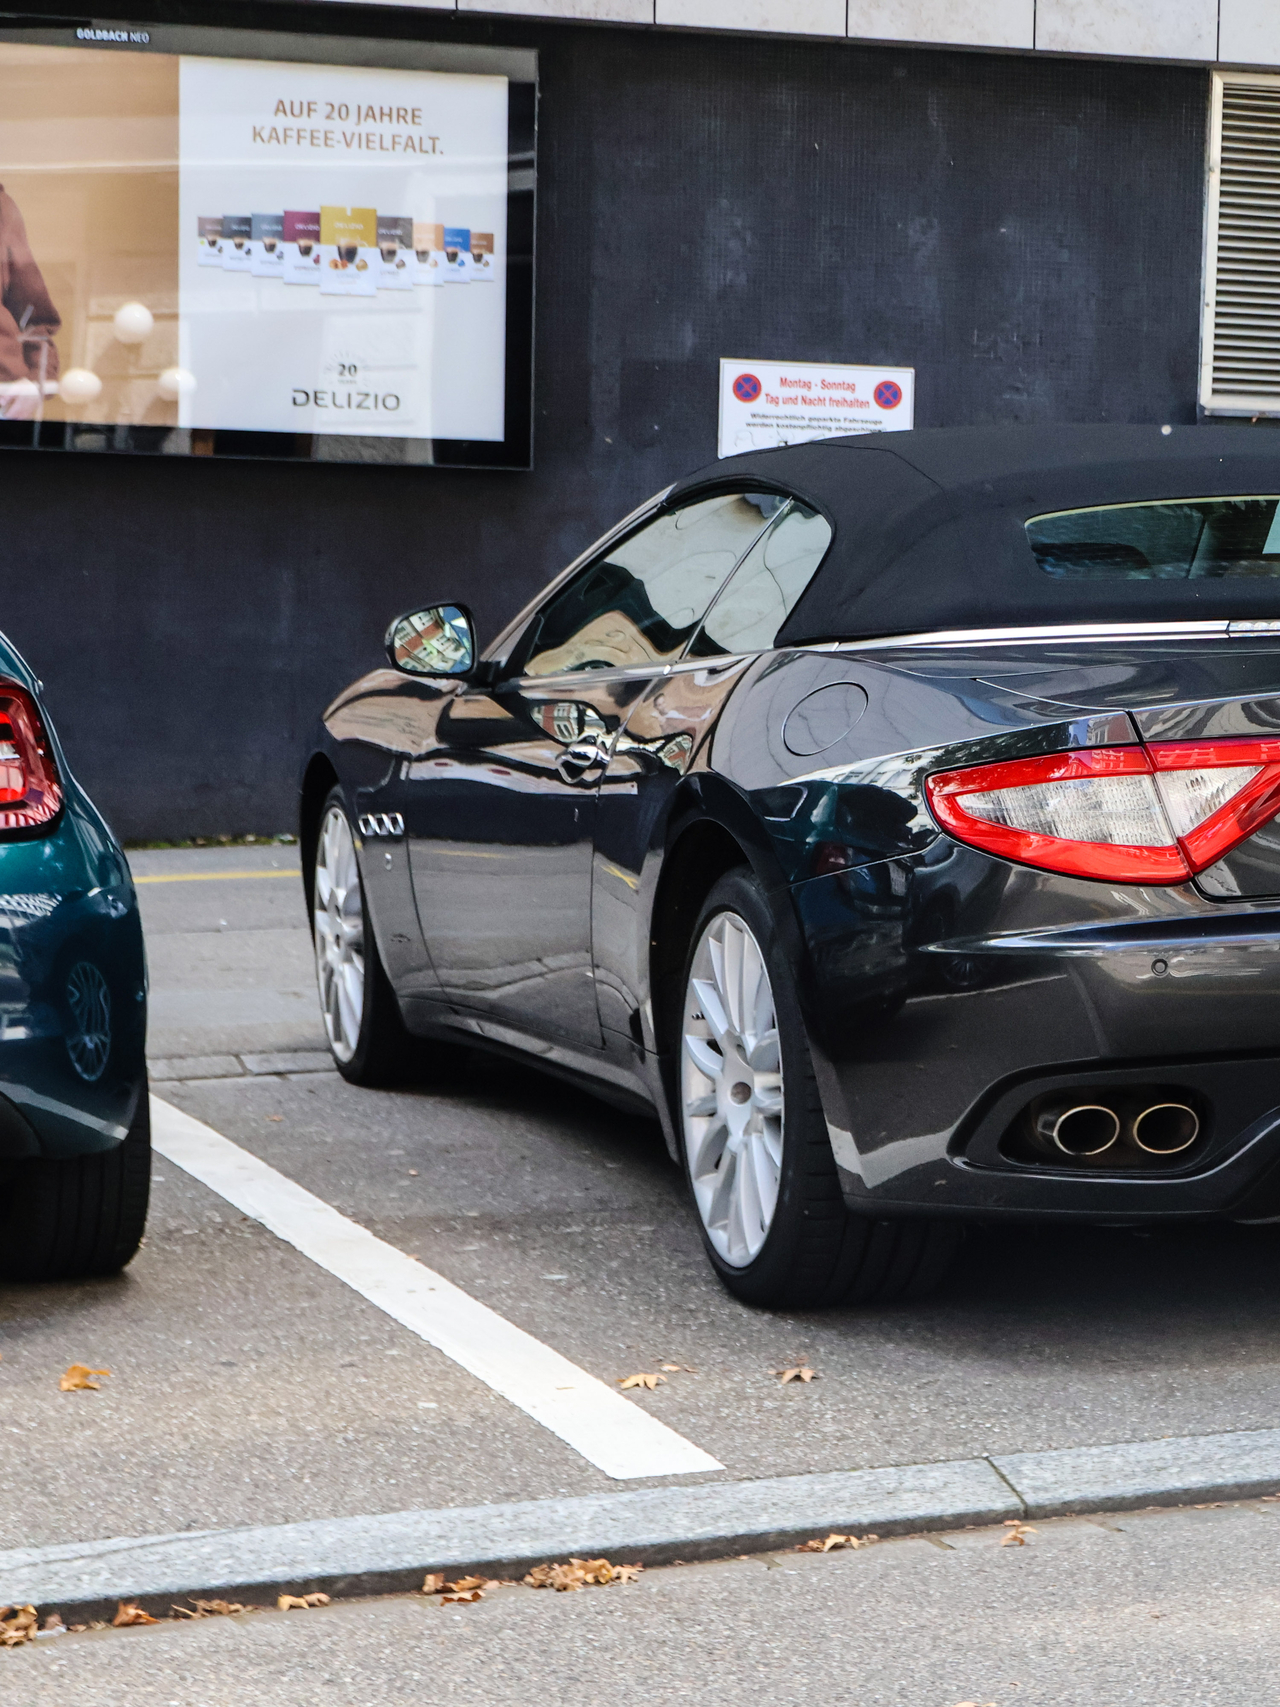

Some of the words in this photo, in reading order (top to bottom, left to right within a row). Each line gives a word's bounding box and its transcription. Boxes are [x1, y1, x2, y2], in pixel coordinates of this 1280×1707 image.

[76, 27, 129, 42] GOLDBACH
[129, 31, 150, 44] NEO
[274, 98, 319, 119] AUF
[325, 102, 350, 122] 20
[355, 103, 423, 126] JAHRE
[252, 125, 444, 155] KAFFEE-VIELFALT.
[337, 362, 358, 377] 20
[780, 377, 812, 391] Montag
[821, 379, 856, 394] Sonntag
[292, 388, 401, 412] DELIZIO
[765, 393, 779, 407] Tag
[782, 395, 799, 406] und
[801, 395, 826, 407] Nacht
[829, 396, 870, 409] freihalten
[843, 417, 883, 425] Fahrzeuge
